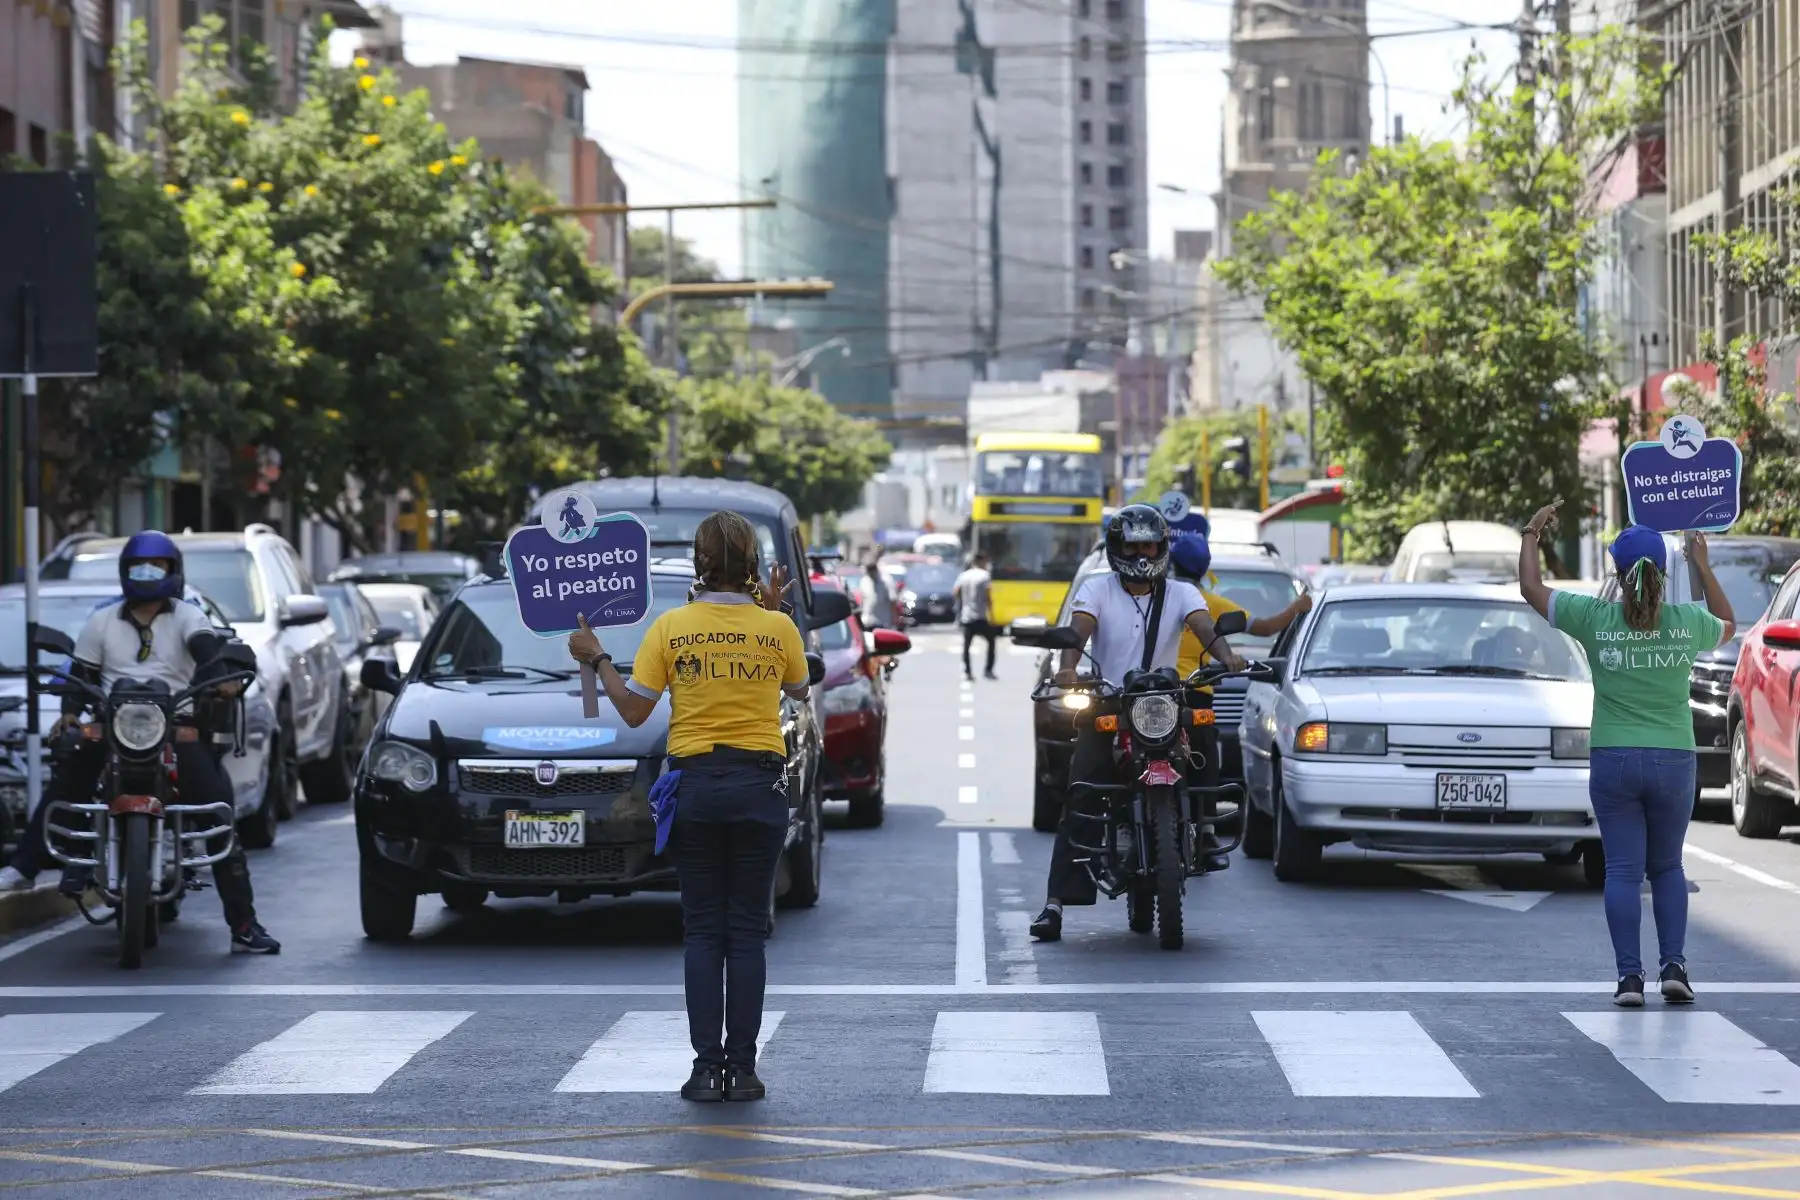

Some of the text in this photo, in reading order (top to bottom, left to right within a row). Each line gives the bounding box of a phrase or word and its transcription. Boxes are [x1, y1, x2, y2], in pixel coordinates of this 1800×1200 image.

[1634, 467, 1732, 488] No te distraigas
[1641, 485, 1724, 503] con el celular
[521, 547, 638, 573] Yo respeto
[532, 572, 636, 601] al peatón
[670, 632, 783, 651] EDUCADOR VIAL
[1595, 628, 1692, 642] EDUCADOR VIAL
[711, 652, 772, 663] MUNICIPALIDAD
[1631, 652, 1691, 668] LIMA
[711, 661, 778, 681] LIMA
[498, 727, 600, 739] MOVITAXI
[539, 767, 554, 779] FIAT
[1459, 775, 1484, 783] PERU
[1440, 783, 1502, 803] Z5Q-042
[508, 821, 580, 844] AHN-392
